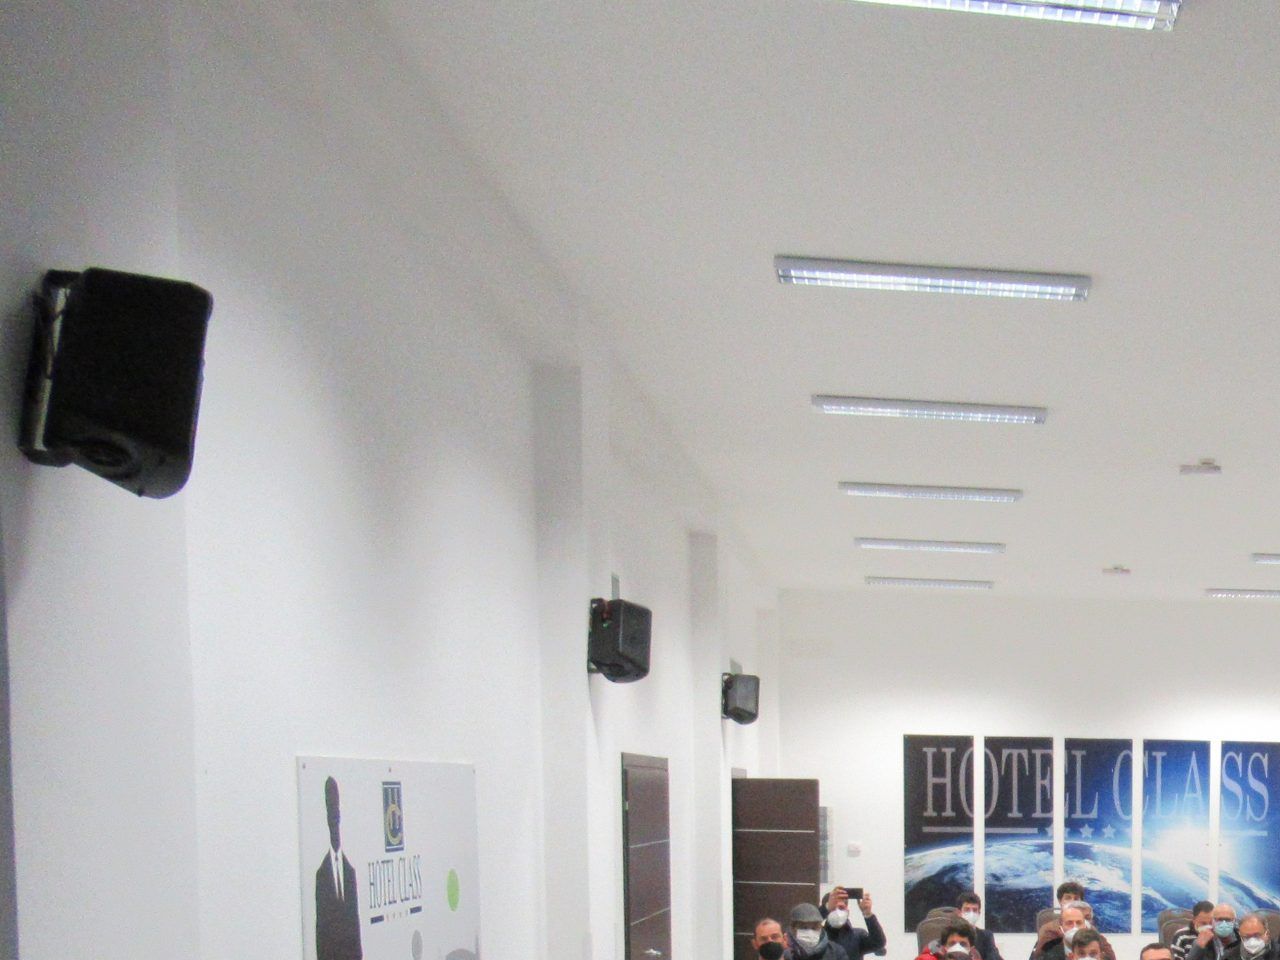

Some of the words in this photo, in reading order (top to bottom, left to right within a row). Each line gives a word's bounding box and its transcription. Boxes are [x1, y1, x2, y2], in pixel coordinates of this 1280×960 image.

[921, 747, 1099, 819] HOTEL
[1112, 748, 1270, 822] CLASS
[368, 859, 397, 909] HOTEL
